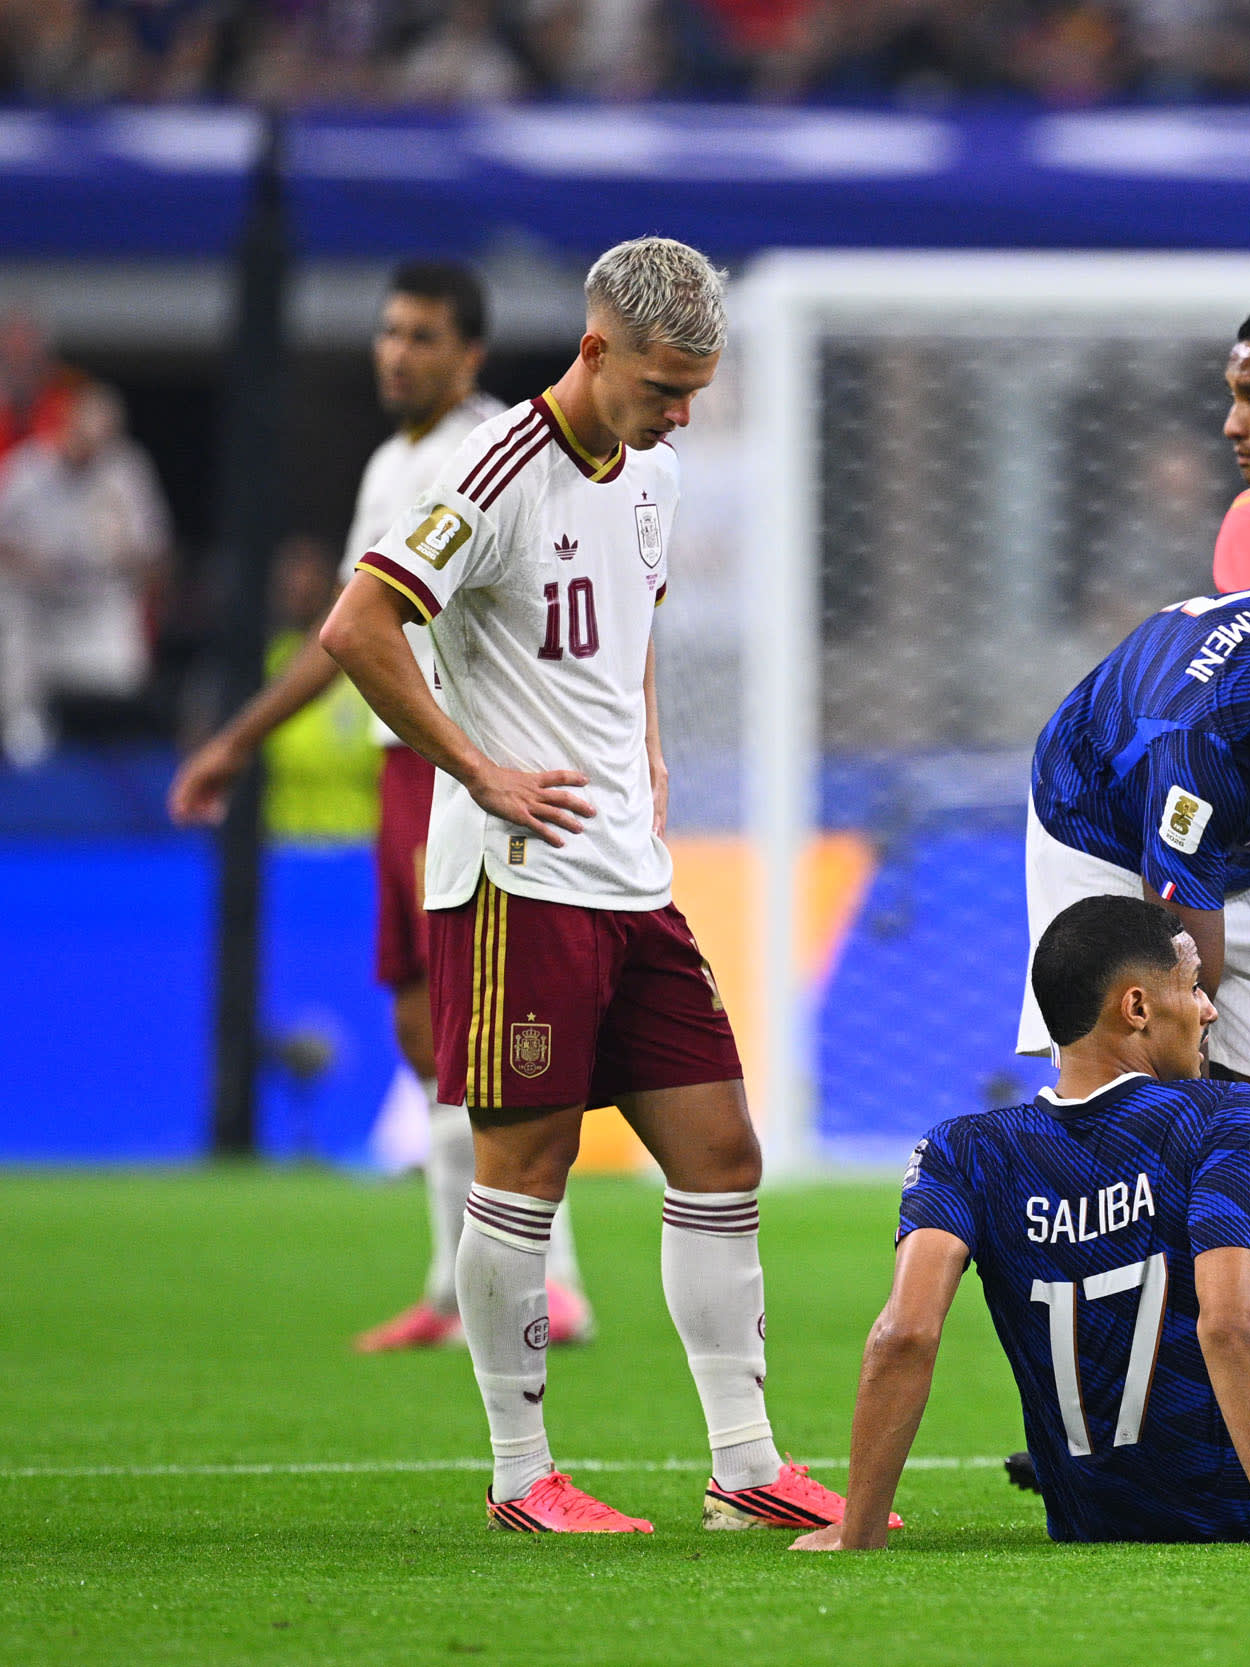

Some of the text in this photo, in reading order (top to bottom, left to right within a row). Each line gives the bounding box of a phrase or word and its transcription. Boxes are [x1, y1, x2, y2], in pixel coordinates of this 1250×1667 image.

[537, 576, 600, 661] 10
[1026, 1172, 1156, 1244] SALIBA
[1030, 1252, 1168, 1457] 17
